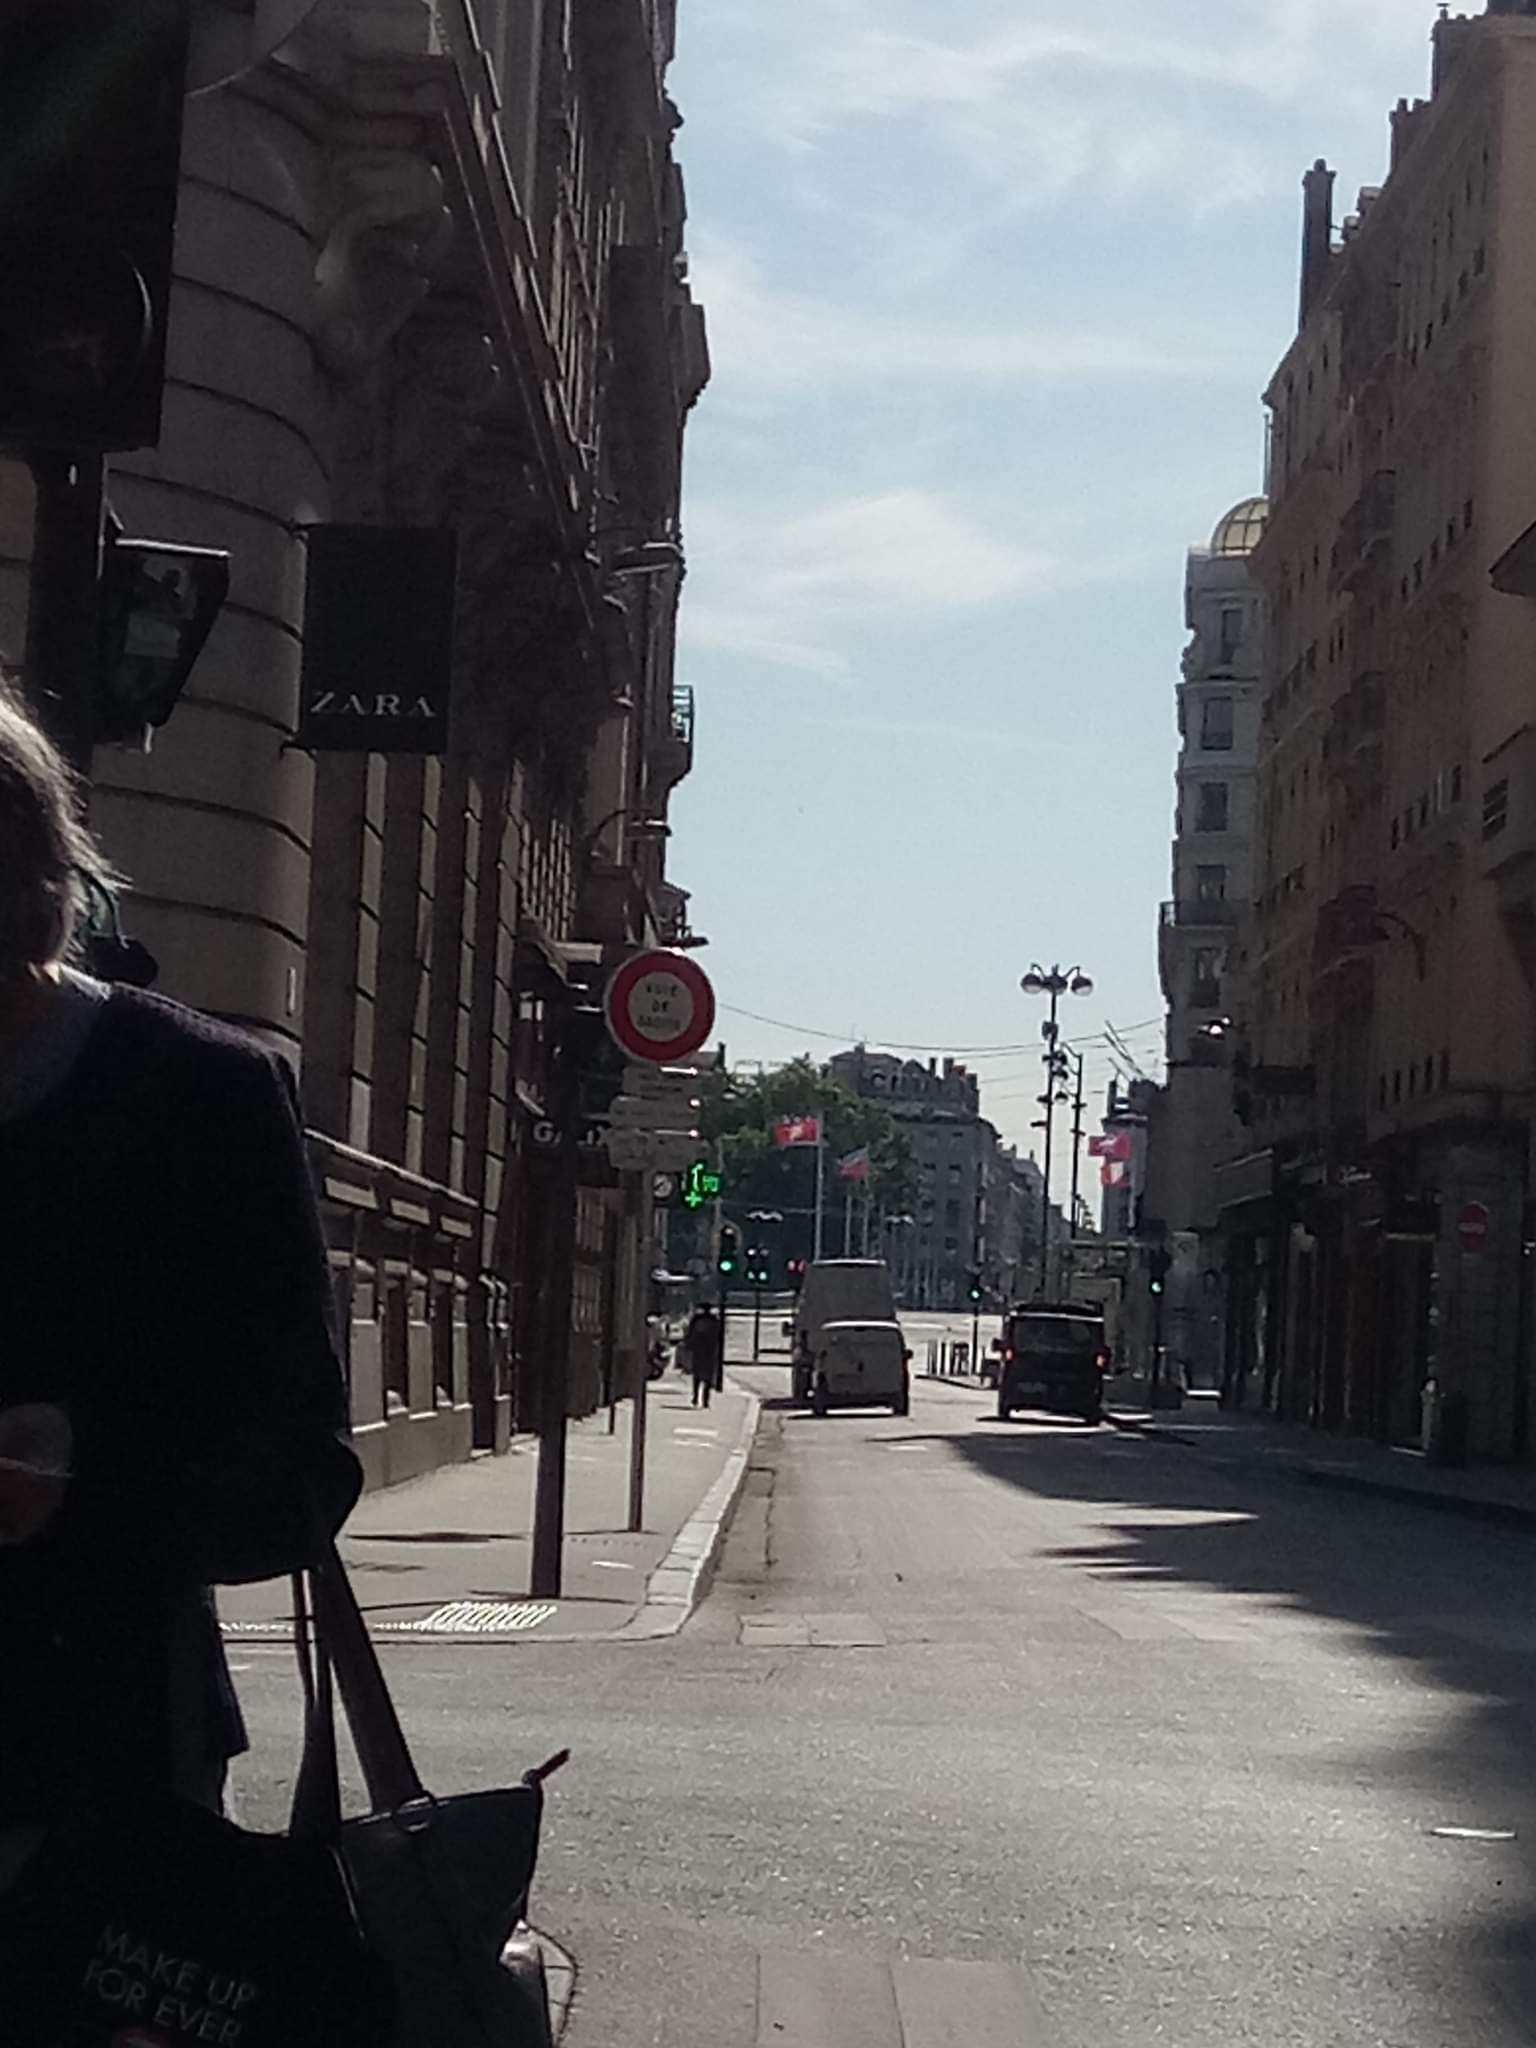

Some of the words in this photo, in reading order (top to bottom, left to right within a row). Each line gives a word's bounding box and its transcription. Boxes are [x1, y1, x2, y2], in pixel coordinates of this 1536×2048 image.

[310, 690, 436, 718] ZARA
[81, 1958, 148, 2013] FOR
[152, 1994, 243, 2047] EVER
[97, 1923, 200, 1994] MAKE
[207, 1972, 258, 2012] UP
